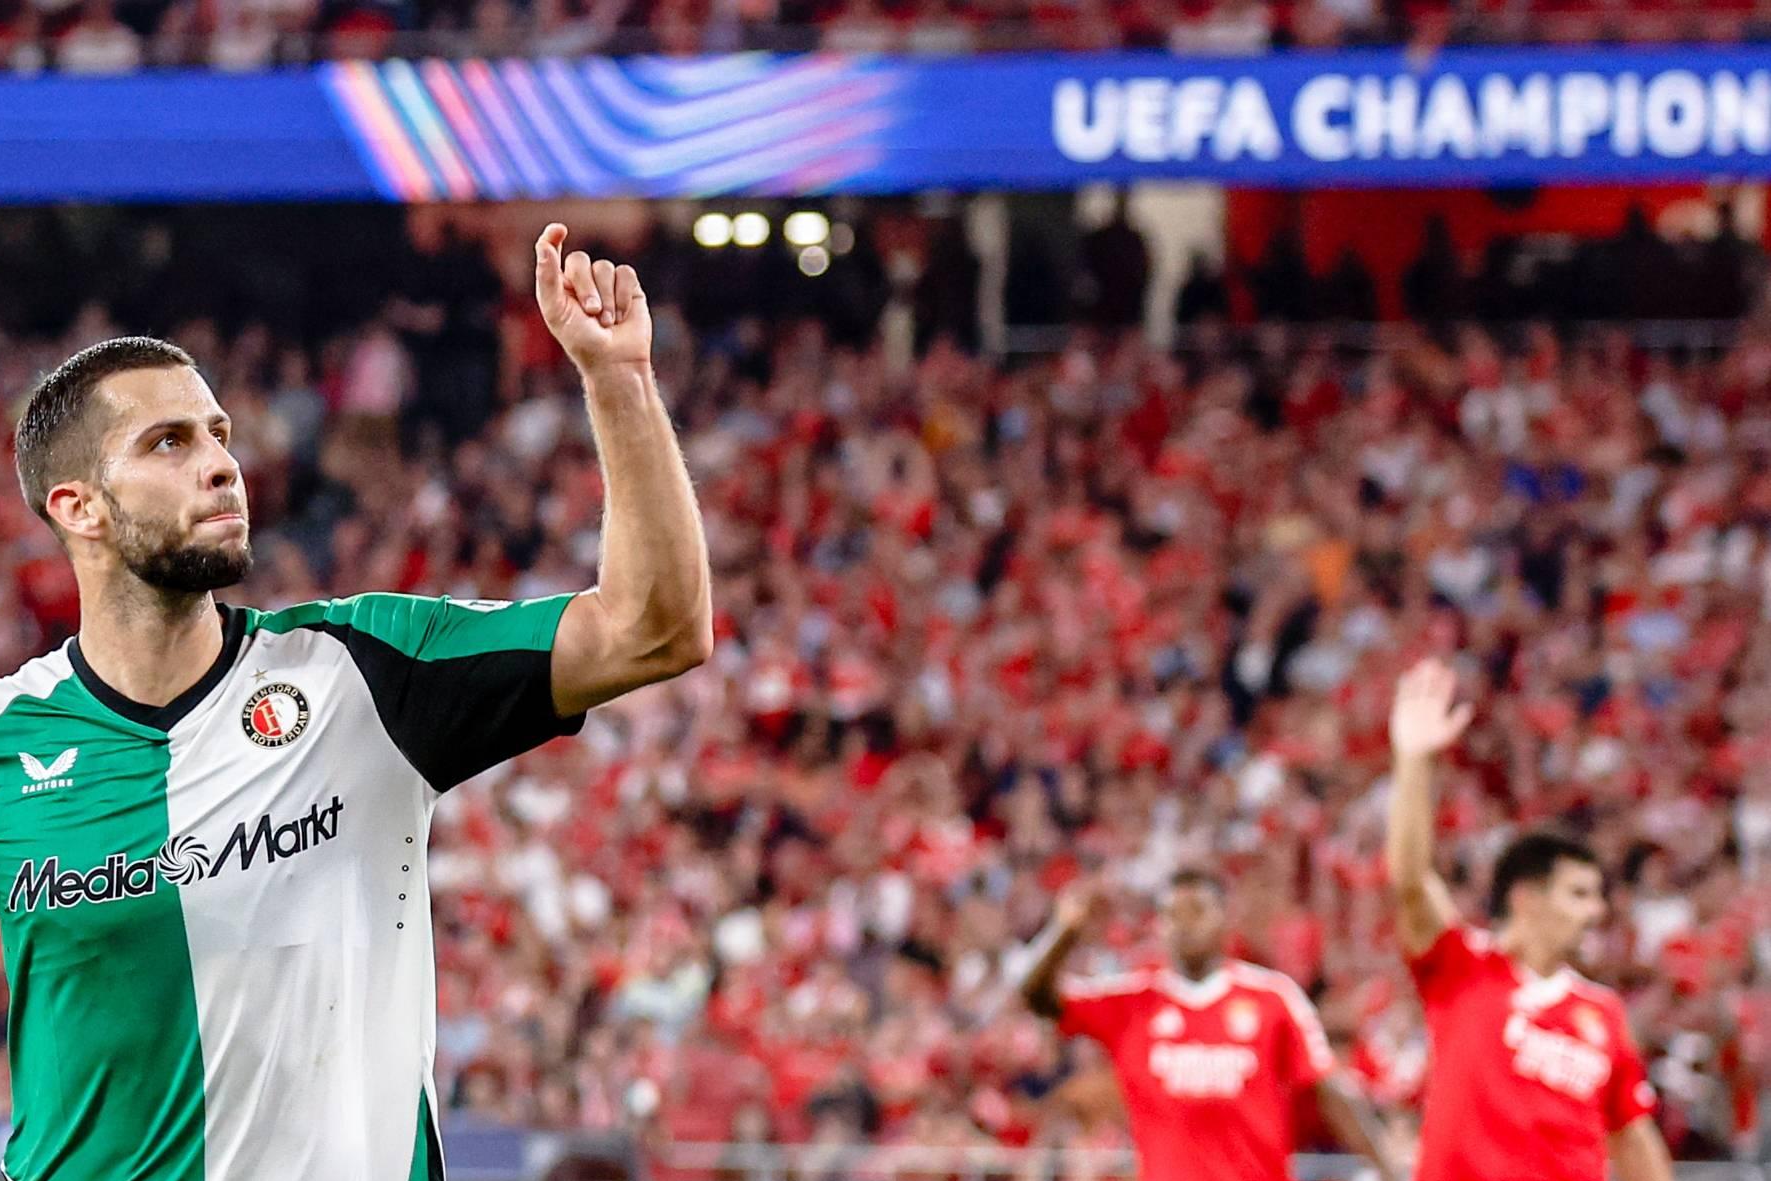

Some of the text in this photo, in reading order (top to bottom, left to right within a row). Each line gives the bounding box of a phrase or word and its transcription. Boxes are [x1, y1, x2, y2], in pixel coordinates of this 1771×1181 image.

[1053, 78, 1281, 162] UEFA
[243, 685, 298, 718] FEYENOORD
[251, 711, 308, 746] ROTTERDAM
[21, 779, 74, 794] CASTORE
[8, 796, 344, 912] Media Markt
